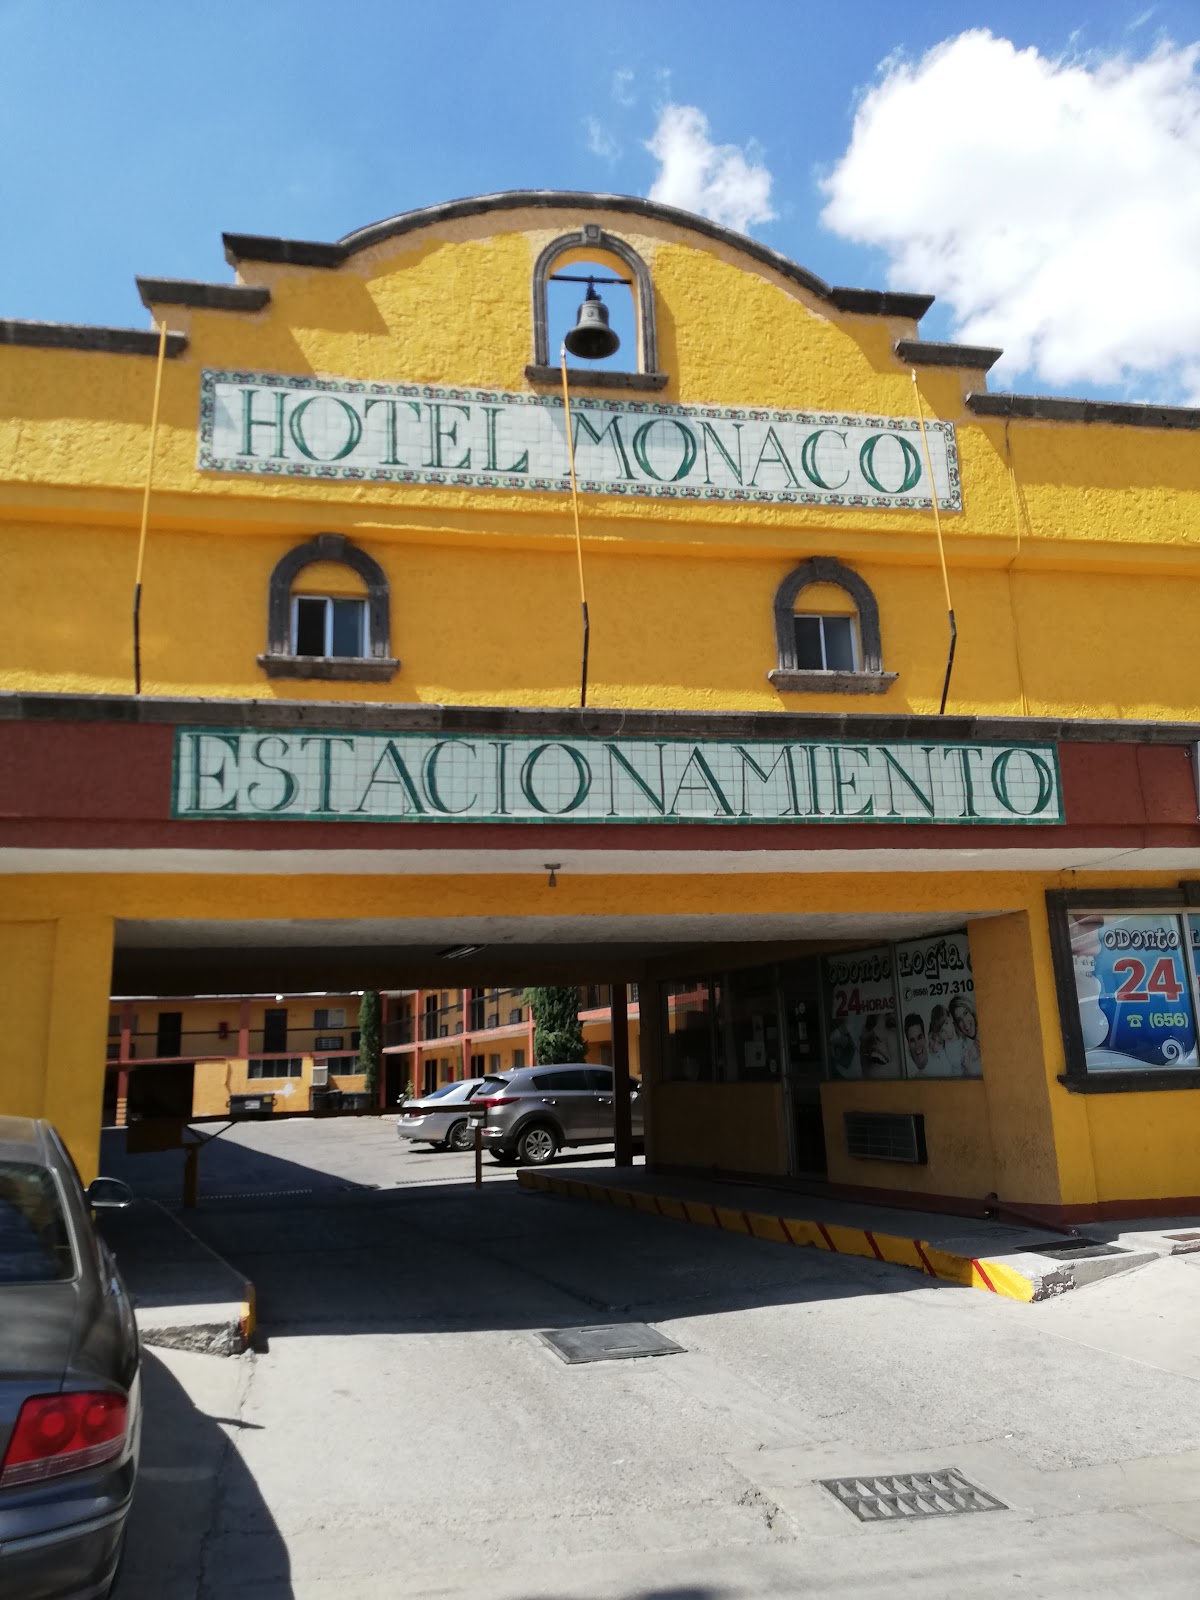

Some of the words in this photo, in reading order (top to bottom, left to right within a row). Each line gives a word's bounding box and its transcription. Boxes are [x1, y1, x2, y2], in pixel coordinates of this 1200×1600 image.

[236, 388, 529, 475] HOTEL
[562, 411, 923, 494] MONACO
[184, 732, 1054, 818] ESTACIONAMIENTO
[835, 987, 862, 1017] 24
[861, 996, 895, 1013] HORAS
[1113, 957, 1184, 1002] 24
[1149, 1012, 1189, 1029] (656)
